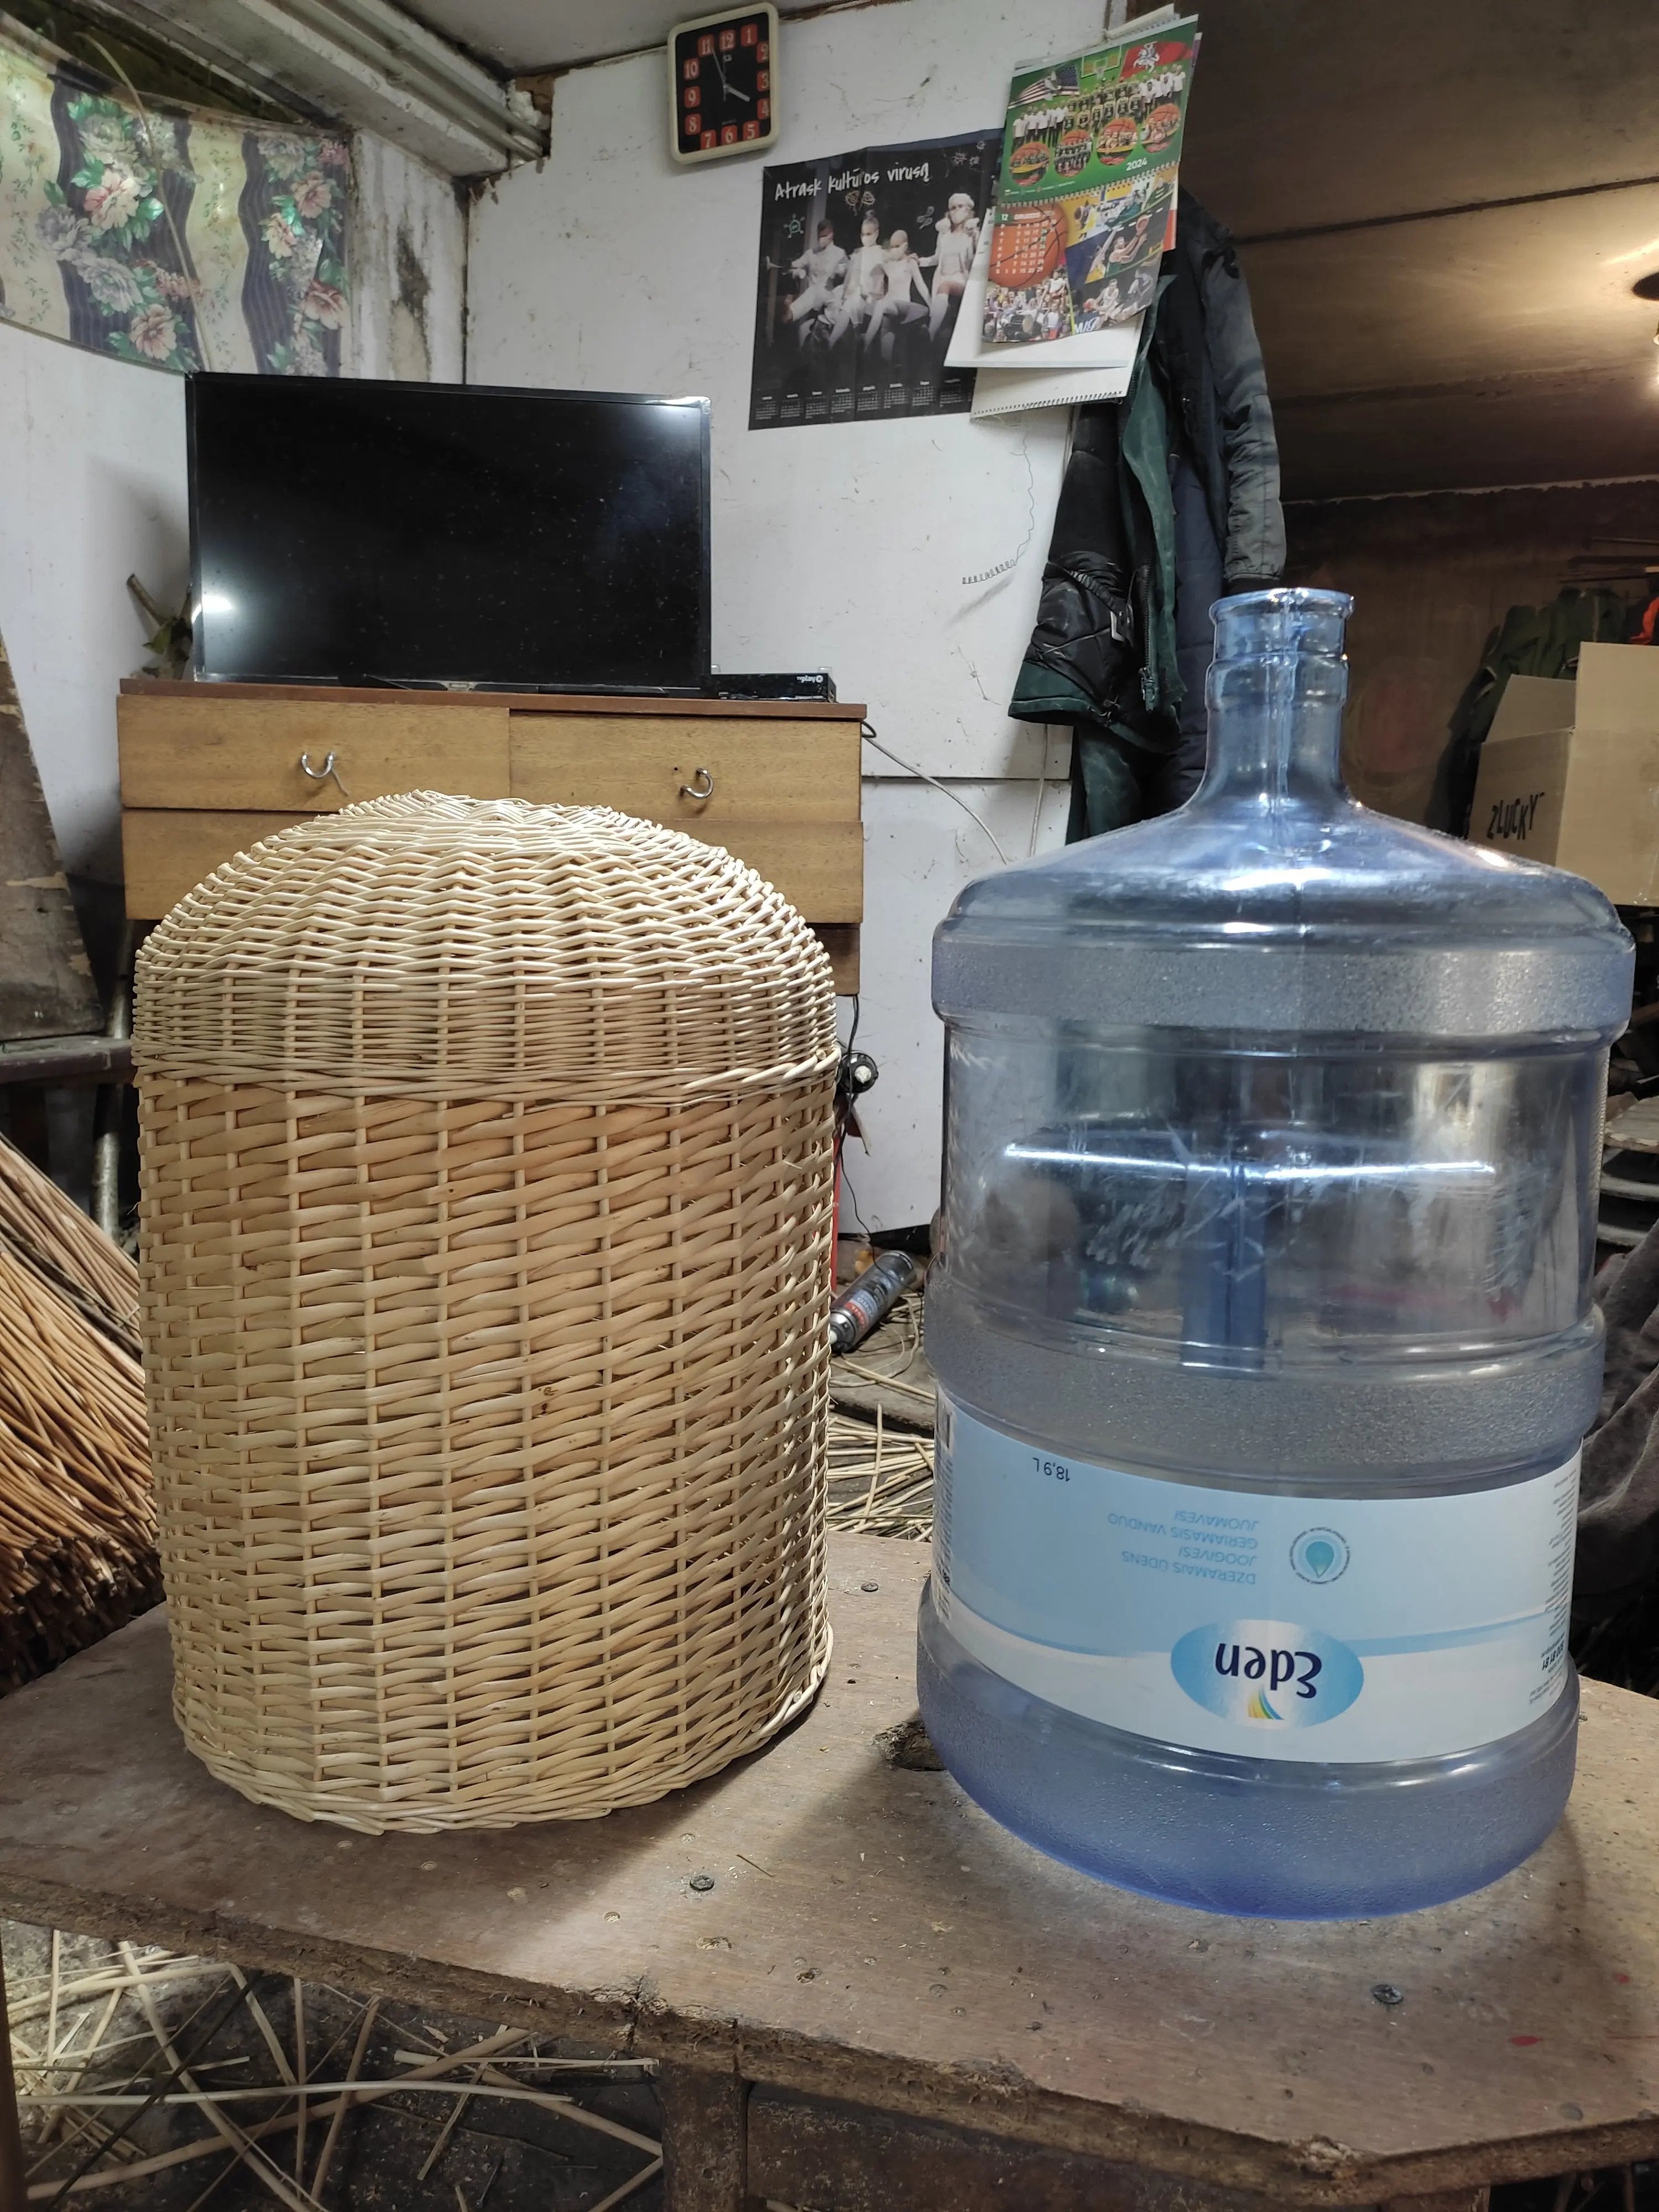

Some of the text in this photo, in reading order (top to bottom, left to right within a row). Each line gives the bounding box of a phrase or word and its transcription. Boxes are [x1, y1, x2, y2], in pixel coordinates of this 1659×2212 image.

[702, 38, 711, 55] 11
[720, 33, 734, 50] 12
[761, 45, 769, 60] 2
[686, 61, 699, 79] 10
[761, 73, 769, 89] 3
[688, 91, 696, 106] 9
[761, 102, 769, 117] 4
[689, 117, 696, 133] 8
[747, 123, 755, 138] 5
[704, 133, 712, 148] 7
[725, 128, 733, 144] 6
[1125, 157, 1147, 171] 2024
[774, 178, 823, 201] Atrask
[886, 161, 930, 182] virusą
[1032, 1457, 1071, 1482] 18,9 L
[1174, 1510, 1260, 1531] JUOMAVESI
[1107, 1513, 1258, 1549] GERIAMASIS VANDUO
[1178, 1546, 1258, 1567] JOOGIVESI
[1172, 1562, 1256, 1584] DZERAMAIS
[1215, 1642, 1322, 1699] Eden
